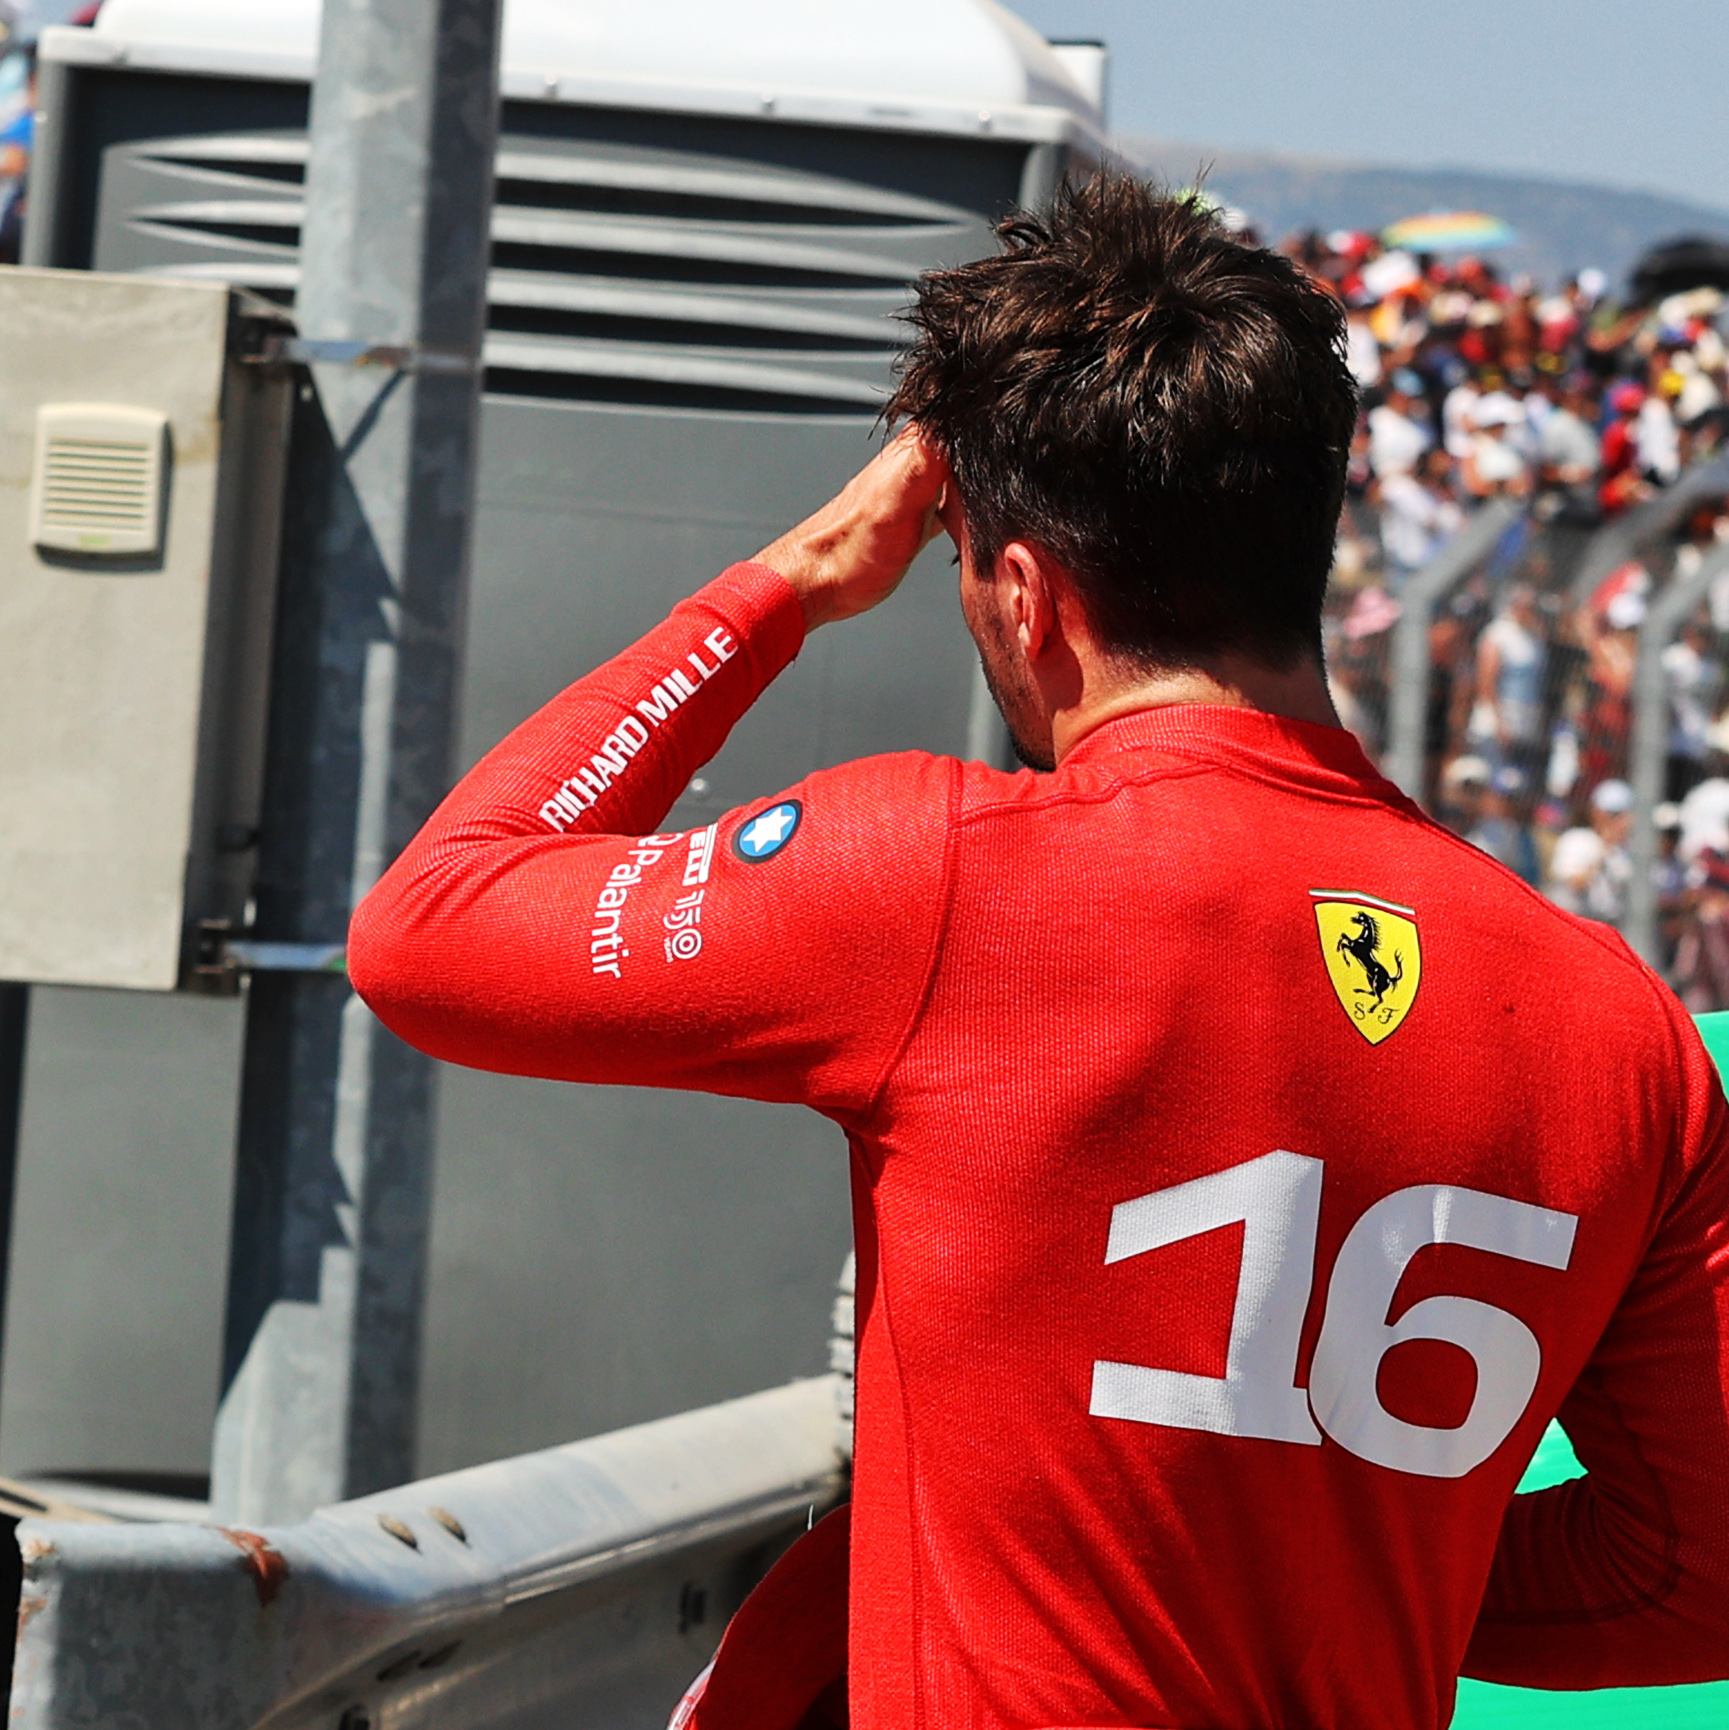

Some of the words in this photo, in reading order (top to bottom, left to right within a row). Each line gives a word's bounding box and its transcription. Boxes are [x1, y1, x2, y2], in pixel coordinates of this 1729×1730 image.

[635, 626, 739, 727] MILLE
[590, 849, 664, 979] Palantir
[1354, 1002, 1365, 1020] S
[1089, 1149, 1579, 1478] 16
